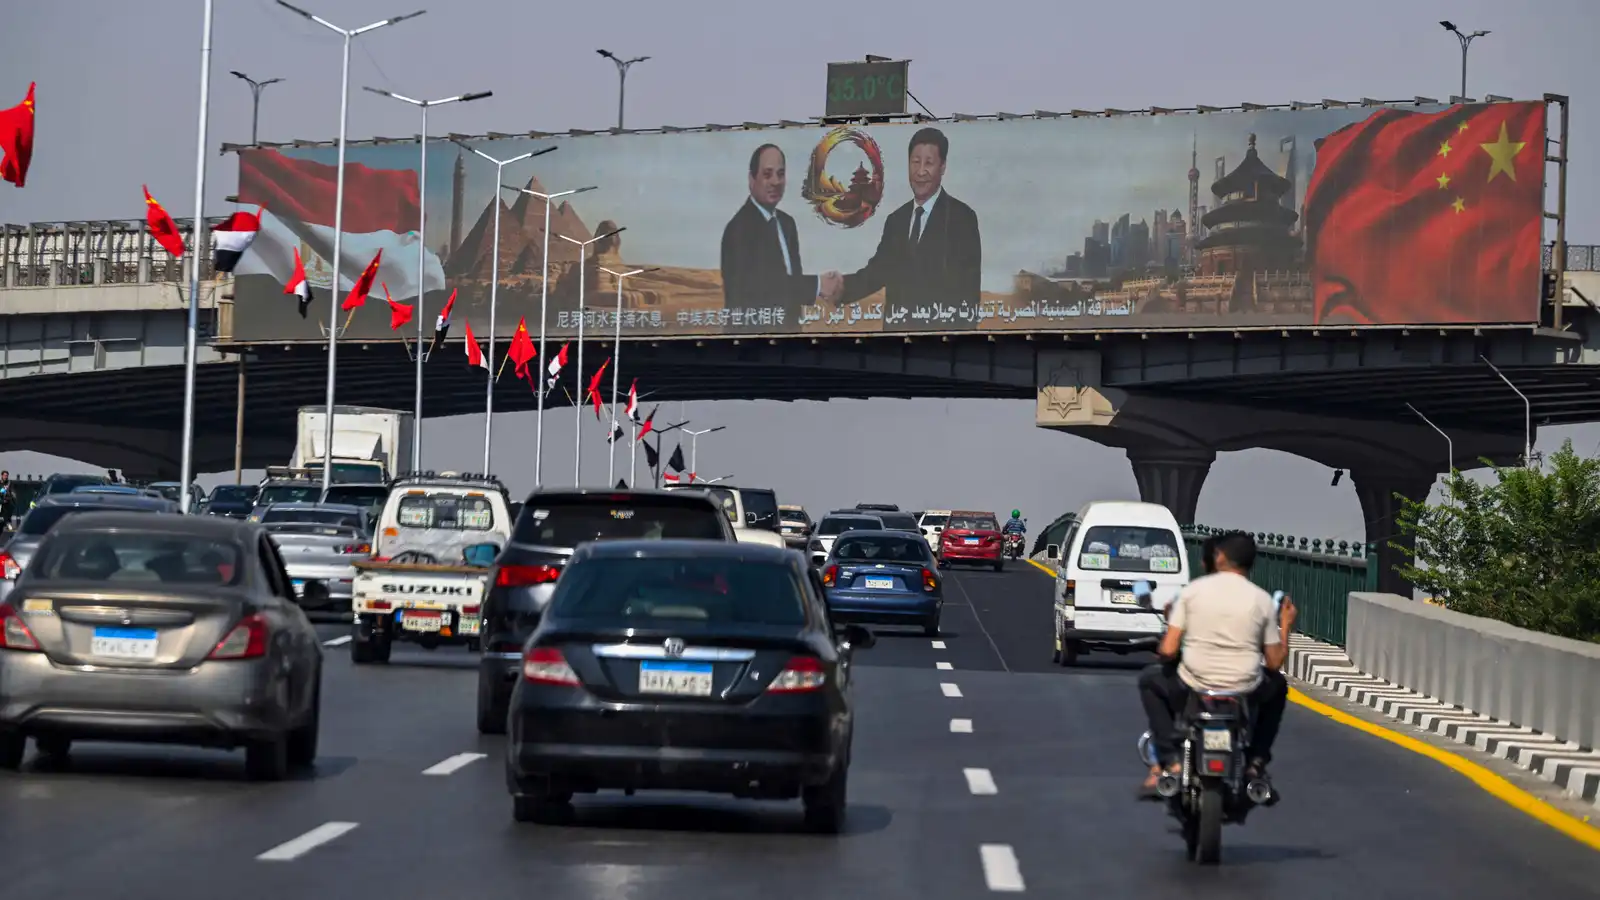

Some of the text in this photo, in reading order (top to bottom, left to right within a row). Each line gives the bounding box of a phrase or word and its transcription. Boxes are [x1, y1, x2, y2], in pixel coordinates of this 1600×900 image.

[829, 74, 902, 102] 35.0°C
[798, 303, 825, 325] النيل
[825, 303, 845, 325] نهر
[847, 302, 883, 325] كتدفق
[885, 303, 909, 324] جيل
[911, 305, 931, 324] بعد
[959, 300, 996, 323] تتوارث
[998, 299, 1040, 322] المصرية
[1041, 299, 1086, 321] الصينية
[1087, 299, 1135, 316] الصداقة
[381, 584, 473, 596] SUZUKI
